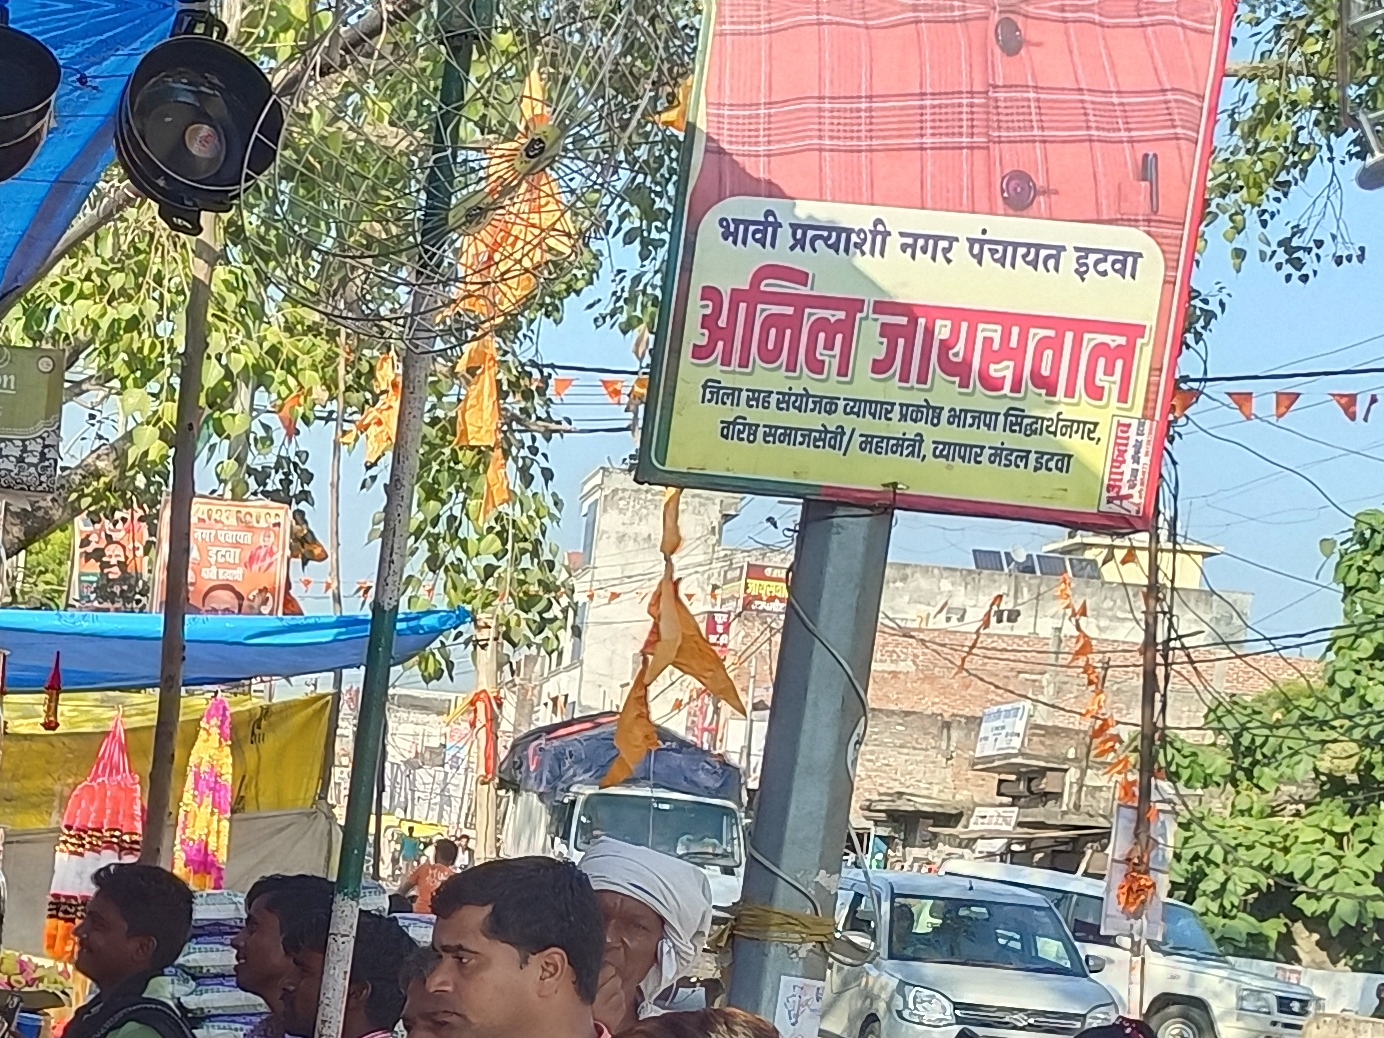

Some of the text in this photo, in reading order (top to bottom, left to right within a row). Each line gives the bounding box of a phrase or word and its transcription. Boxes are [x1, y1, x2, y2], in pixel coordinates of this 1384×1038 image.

[719, 209, 1143, 282] भावी प्रत्याशी नगर पंचायत इटवा
[691, 264, 1146, 405] अनिल जायसवाल
[701, 379, 1101, 445] जिला सह संयोजक व्यापार प्रकोष्ठ भाजपा सिद्धार्थनगर,
[720, 416, 760, 443] वरिष्ठ
[932, 440, 986, 464] व्यापार
[988, 441, 1032, 469] मंडल
[1033, 451, 1074, 473] इटवा
[207, 546, 240, 564] इटवा
